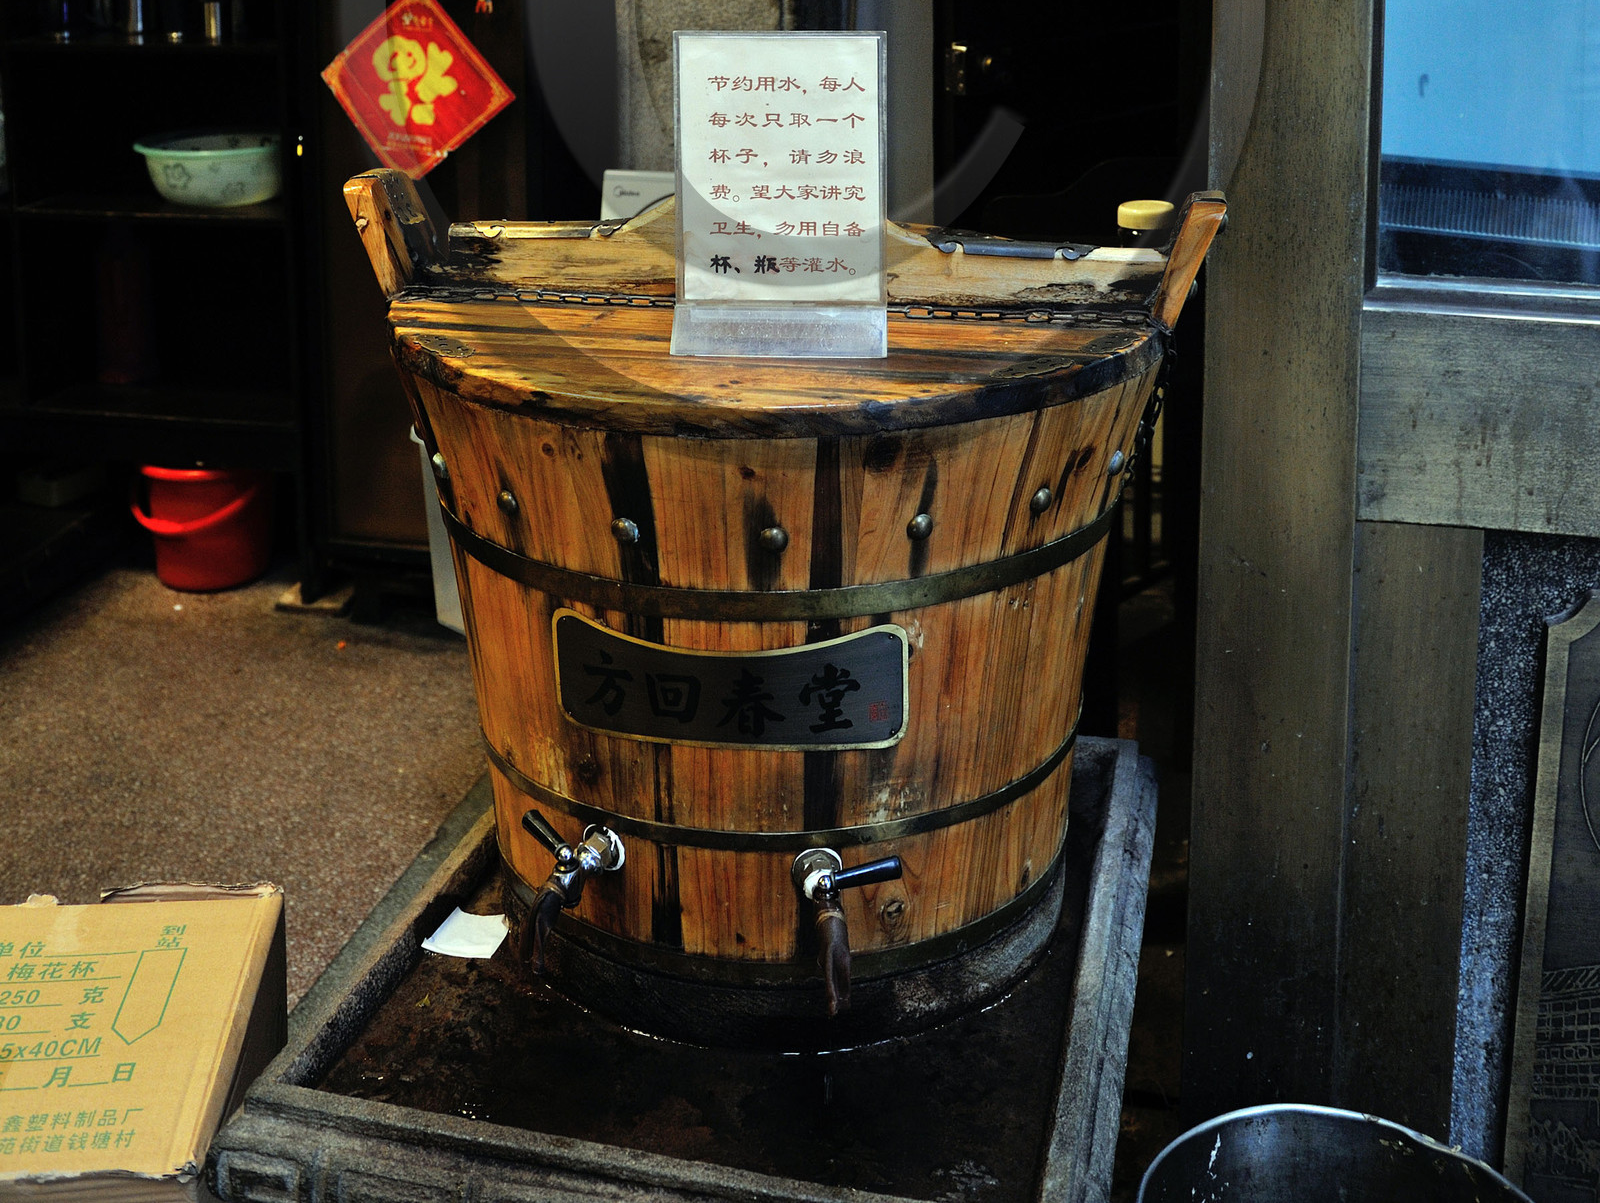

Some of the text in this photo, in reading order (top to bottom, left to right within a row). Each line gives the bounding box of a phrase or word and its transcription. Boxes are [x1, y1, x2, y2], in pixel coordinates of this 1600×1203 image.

[707, 76, 866, 95] 节约用水，每人
[708, 112, 866, 129] 每次只取一个
[708, 149, 866, 168] 杯子，请勿浪
[710, 184, 866, 203] 费。望大家讲究
[709, 220, 866, 239] 卫生，勿用自备
[710, 254, 856, 276] 杯、瓶等灌水。
[582, 650, 861, 737] 方回春堂
[155, 924, 187, 948] 到站
[7, 961, 99, 981] 梅花杯
[78, 986, 109, 1005] 克
[64, 1011, 96, 1031] 支
[42, 1062, 136, 1088] 月 日
[2, 1108, 144, 1133] 鑫塑料制品厂
